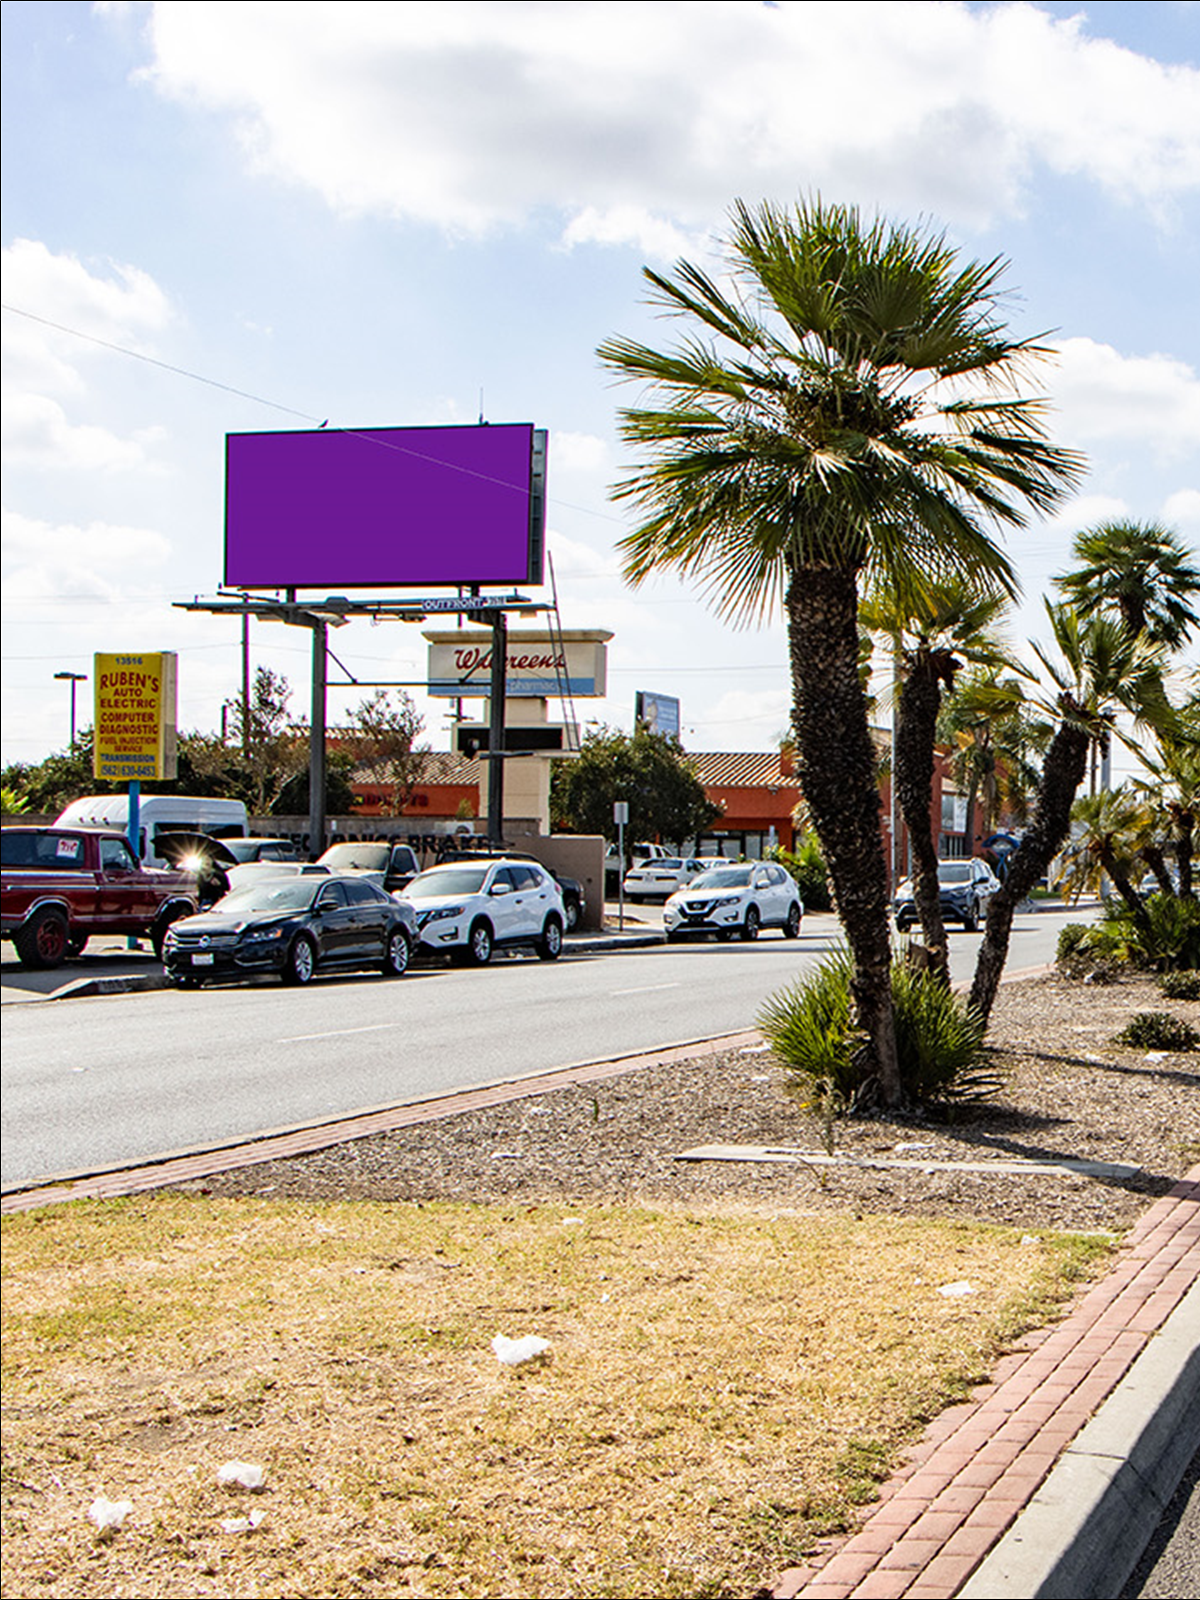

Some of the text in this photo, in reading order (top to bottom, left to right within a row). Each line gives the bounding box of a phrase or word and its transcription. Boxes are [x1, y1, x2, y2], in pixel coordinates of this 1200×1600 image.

[422, 597, 483, 610] OUTFRONT
[115, 657, 143, 665] 13516
[454, 648, 567, 670] Wareens
[100, 671, 159, 693] RUBEN'S
[510, 681, 561, 692] pharmacy
[113, 688, 143, 697] AUTO
[100, 698, 157, 709] ELECTRIC
[100, 712, 155, 722] COMPUTER
[99, 724, 158, 734] DIAGNOSTIC
[100, 737, 157, 745] FUEL INJECTION
[100, 753, 155, 762] TRANSMISSION
